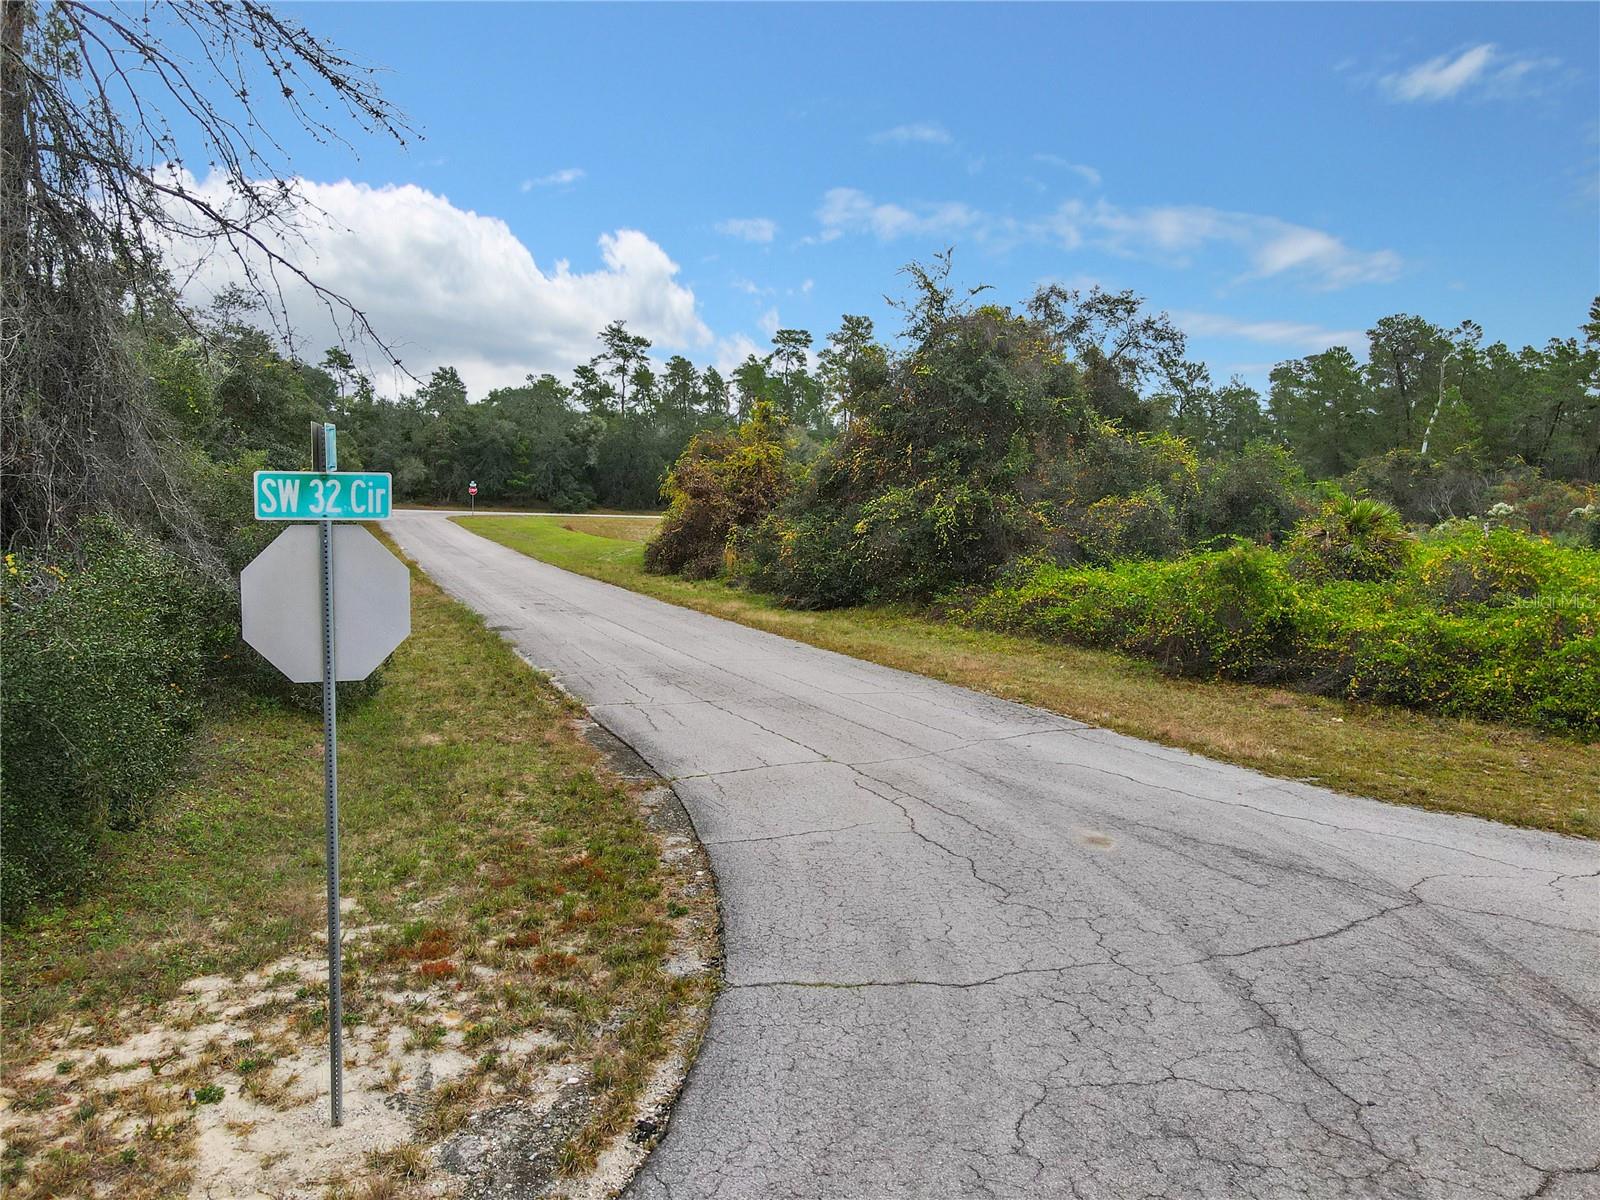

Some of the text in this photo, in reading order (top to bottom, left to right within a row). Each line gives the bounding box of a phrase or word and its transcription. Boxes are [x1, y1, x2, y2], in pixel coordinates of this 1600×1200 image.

[260, 478, 386, 514] SW 32 Cir
